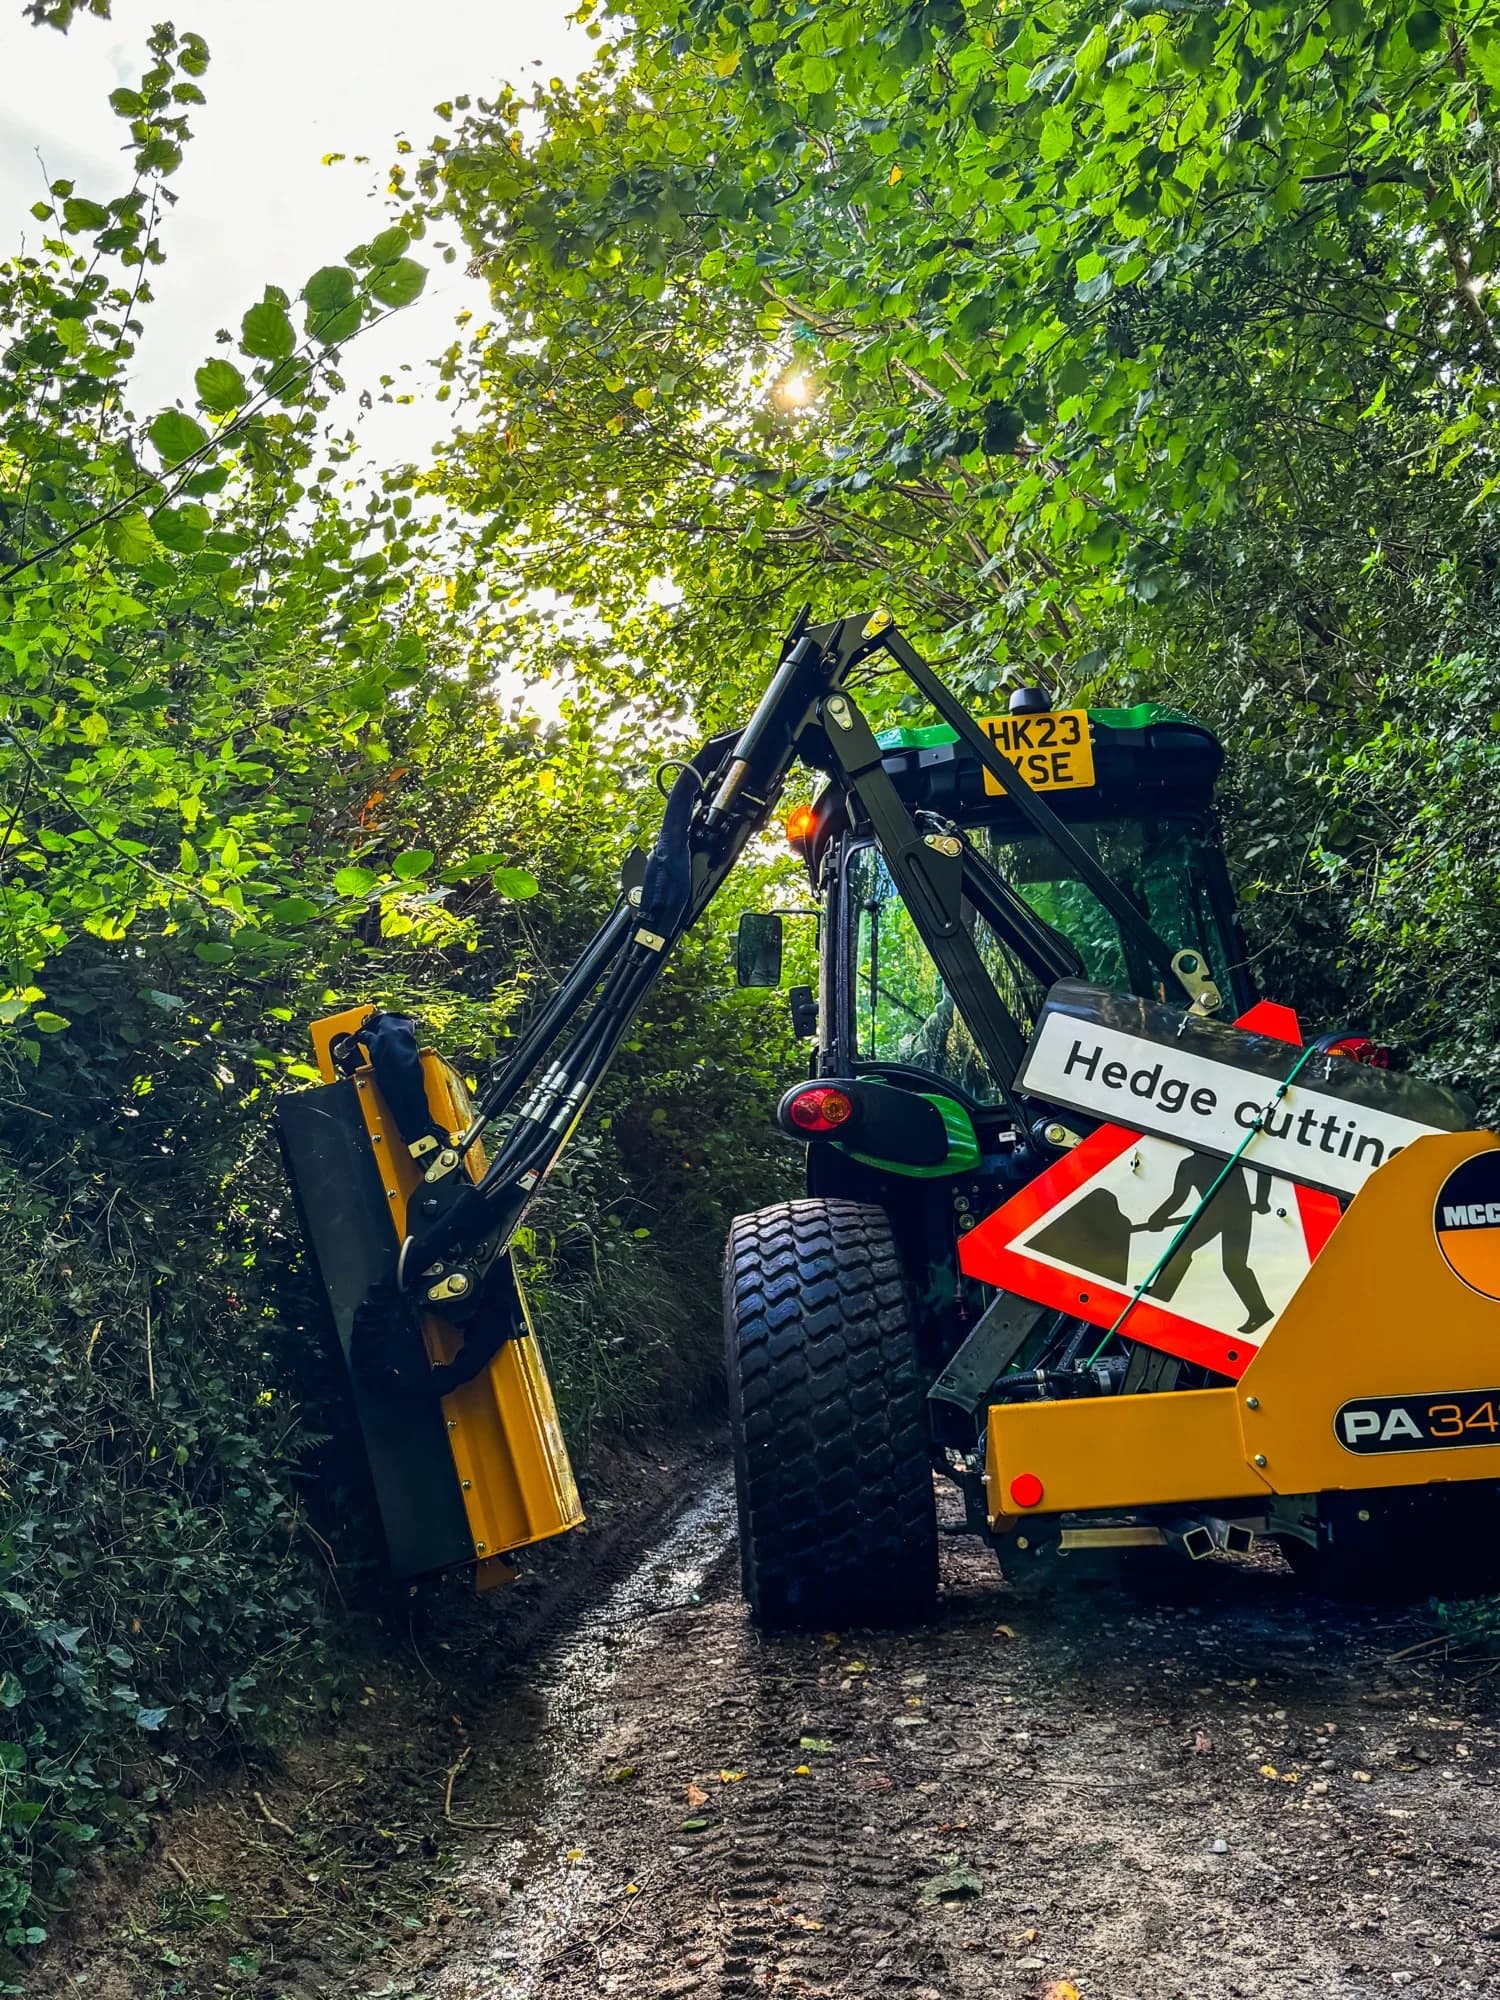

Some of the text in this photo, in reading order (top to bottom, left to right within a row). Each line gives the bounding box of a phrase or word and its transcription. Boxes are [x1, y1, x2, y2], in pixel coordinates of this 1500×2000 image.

[989, 716, 1081, 750] HK23
[1063, 1040, 1217, 1114] Hedge
[1343, 1402, 1500, 1443] PA 34
